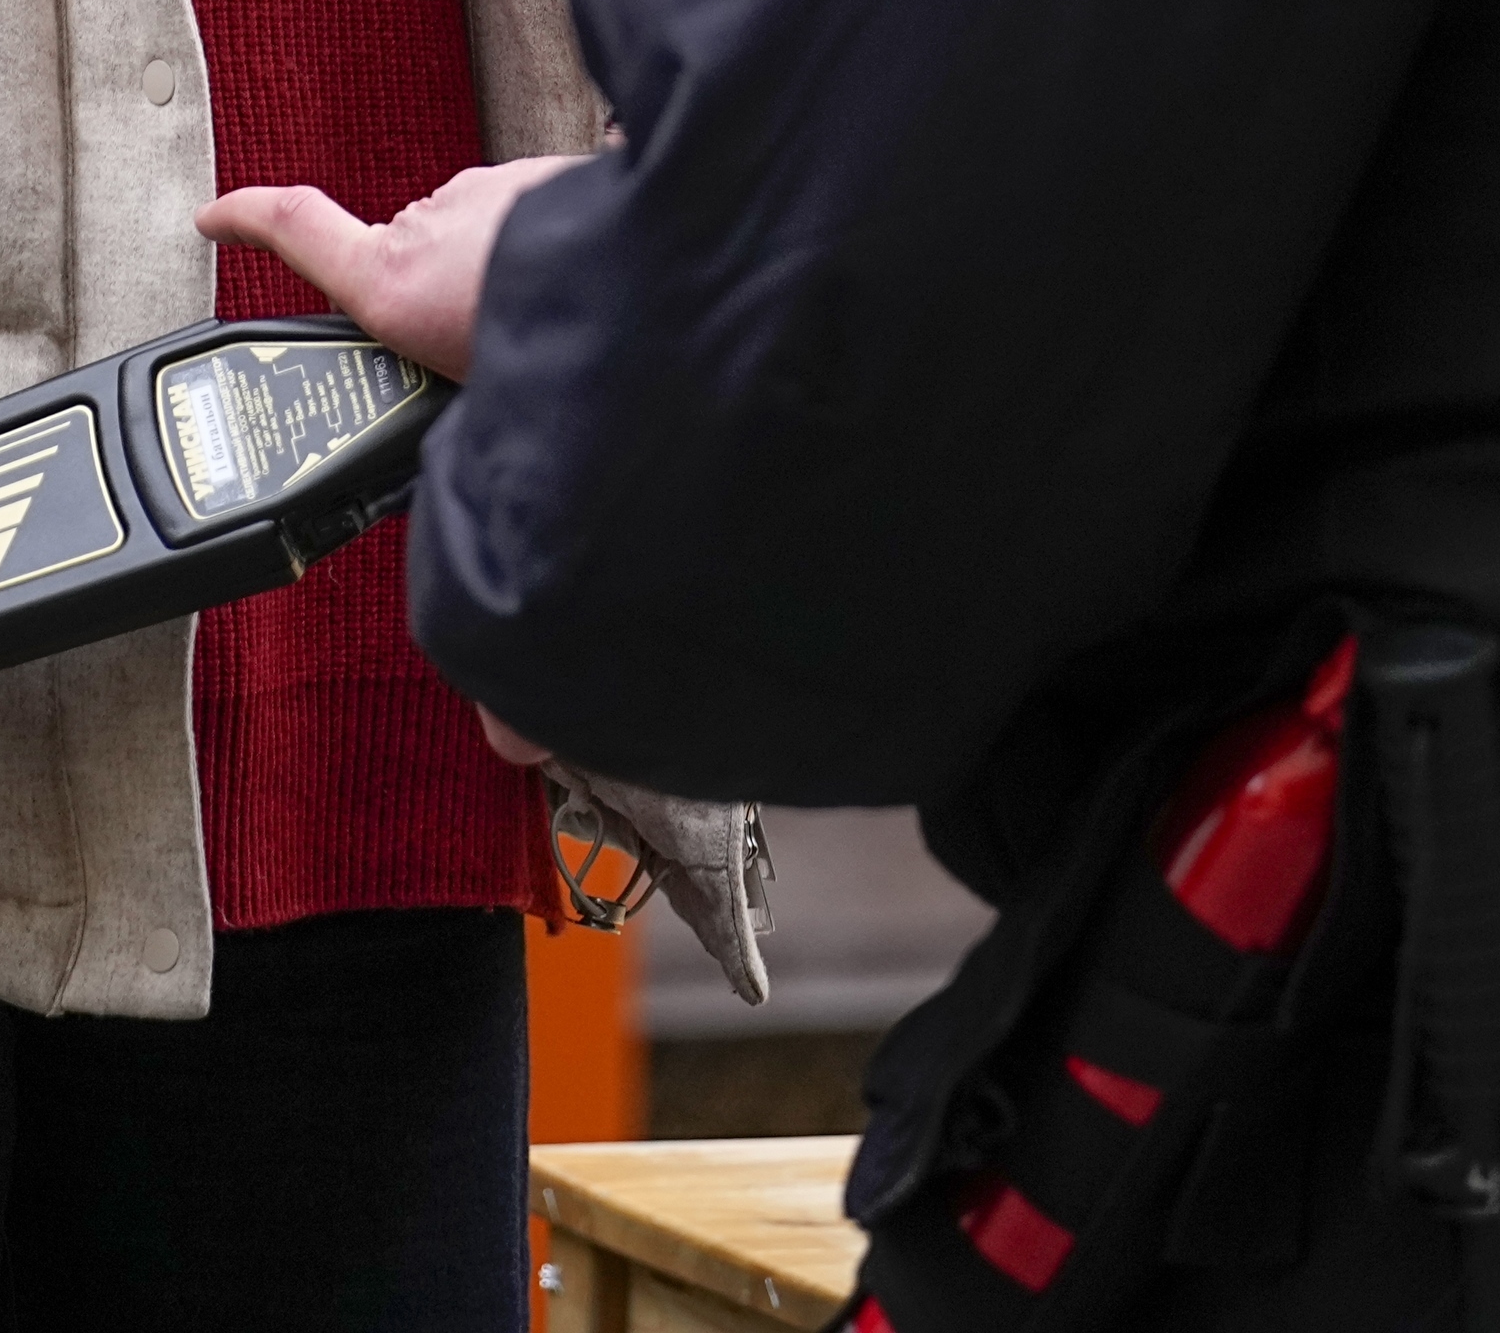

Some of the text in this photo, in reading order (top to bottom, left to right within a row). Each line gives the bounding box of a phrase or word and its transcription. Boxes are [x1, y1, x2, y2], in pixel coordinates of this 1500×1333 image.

[358, 375, 378, 420] Серийный
[372, 355, 392, 395] 111963
[167, 382, 215, 500] УНИСКАН
[199, 392, 228, 472] 1 батальон
[211, 355, 255, 499] СЕЛЕКТИВНЫЙ МЕТАЛЛОДЕТЕКТОР
